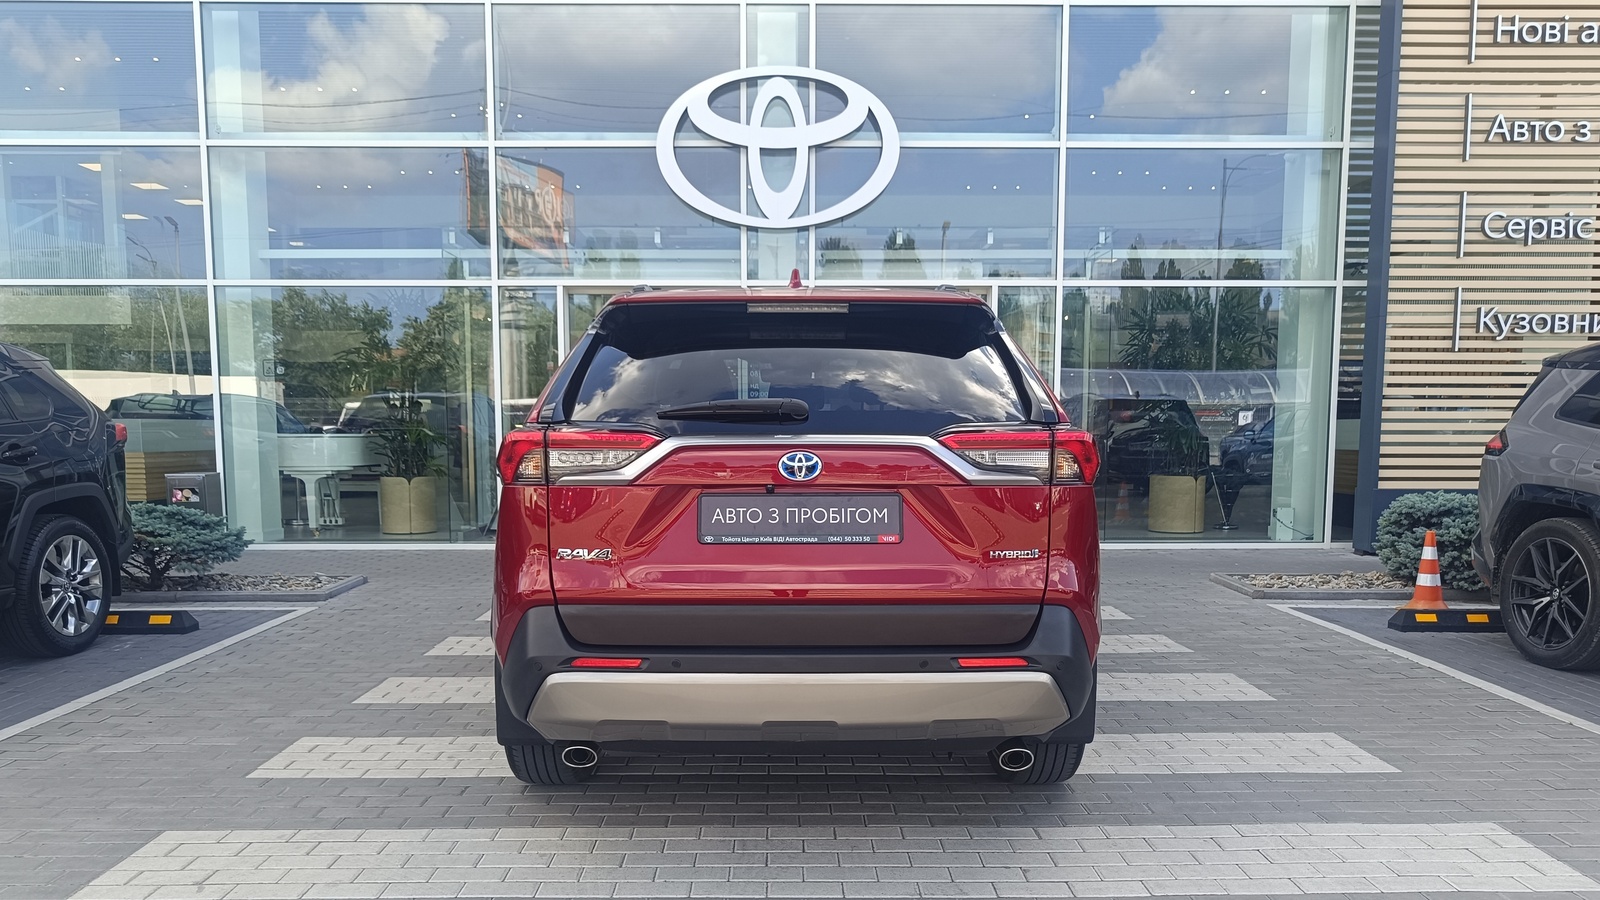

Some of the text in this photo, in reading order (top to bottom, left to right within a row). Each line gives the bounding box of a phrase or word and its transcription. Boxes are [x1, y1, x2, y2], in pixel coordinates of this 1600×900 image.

[1496, 14, 1570, 43] Нові
[1488, 113, 1565, 142] Авто
[1484, 211, 1593, 246] Сервіс
[711, 508, 763, 524] АВТО
[786, 508, 888, 524] ПРОБІГОМ
[556, 548, 612, 560] RAV4
[989, 550, 1033, 559] HYBRID
